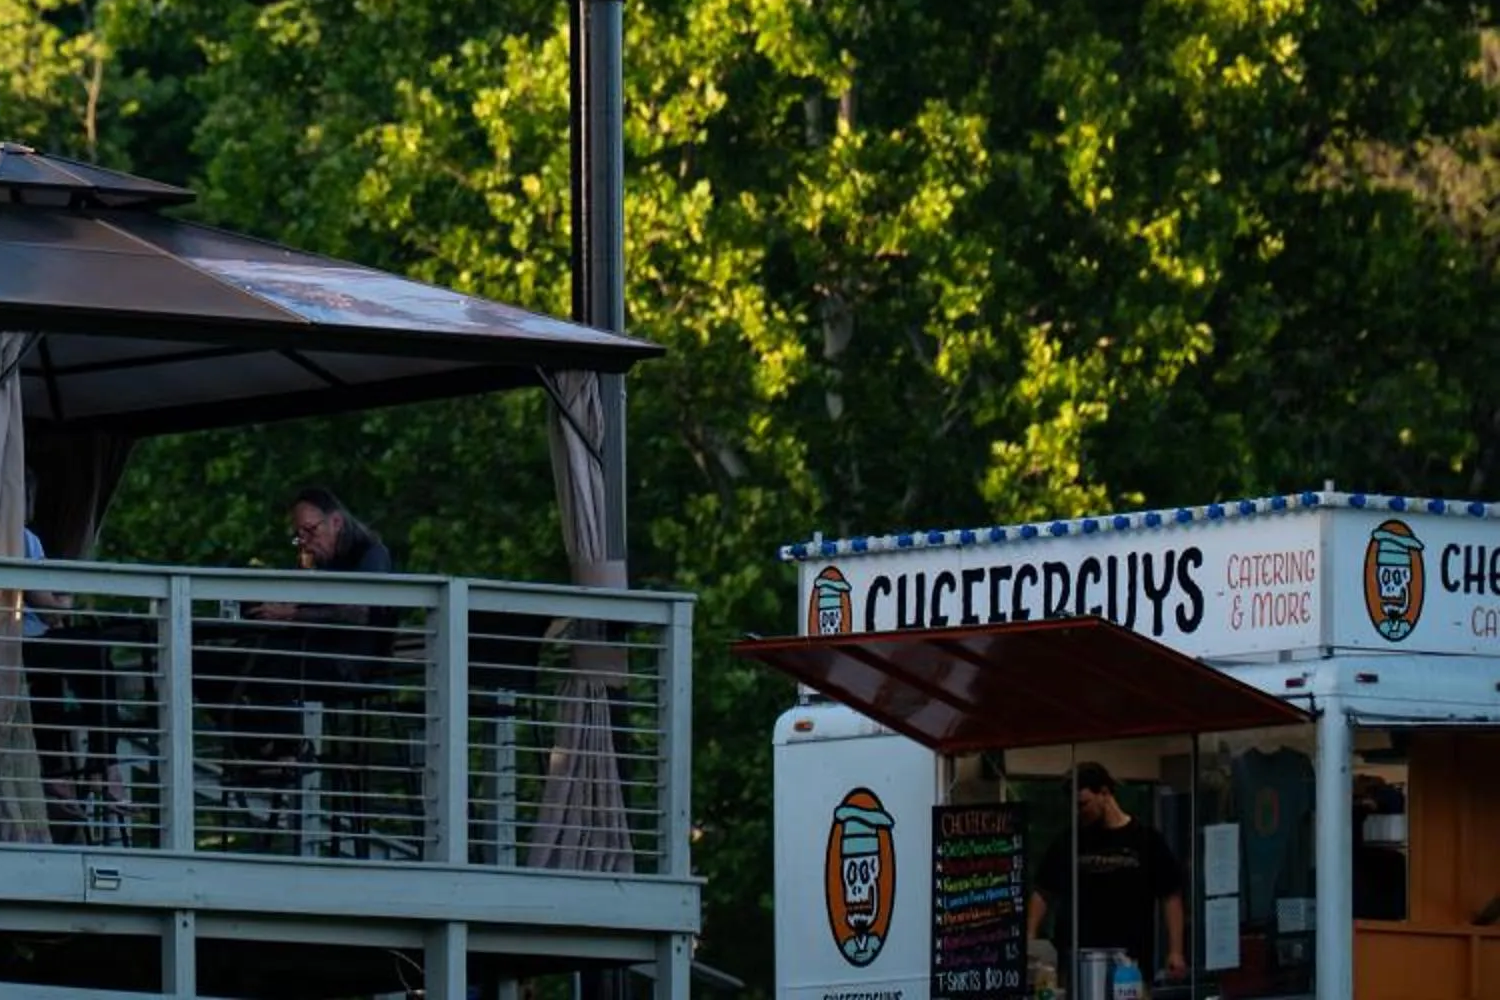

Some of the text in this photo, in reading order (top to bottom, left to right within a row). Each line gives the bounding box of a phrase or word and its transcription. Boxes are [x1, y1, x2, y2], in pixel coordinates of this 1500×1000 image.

[1227, 549, 1316, 590] CATERING
[1231, 591, 1311, 631] & MORE
[1472, 605, 1500, 638] CA
